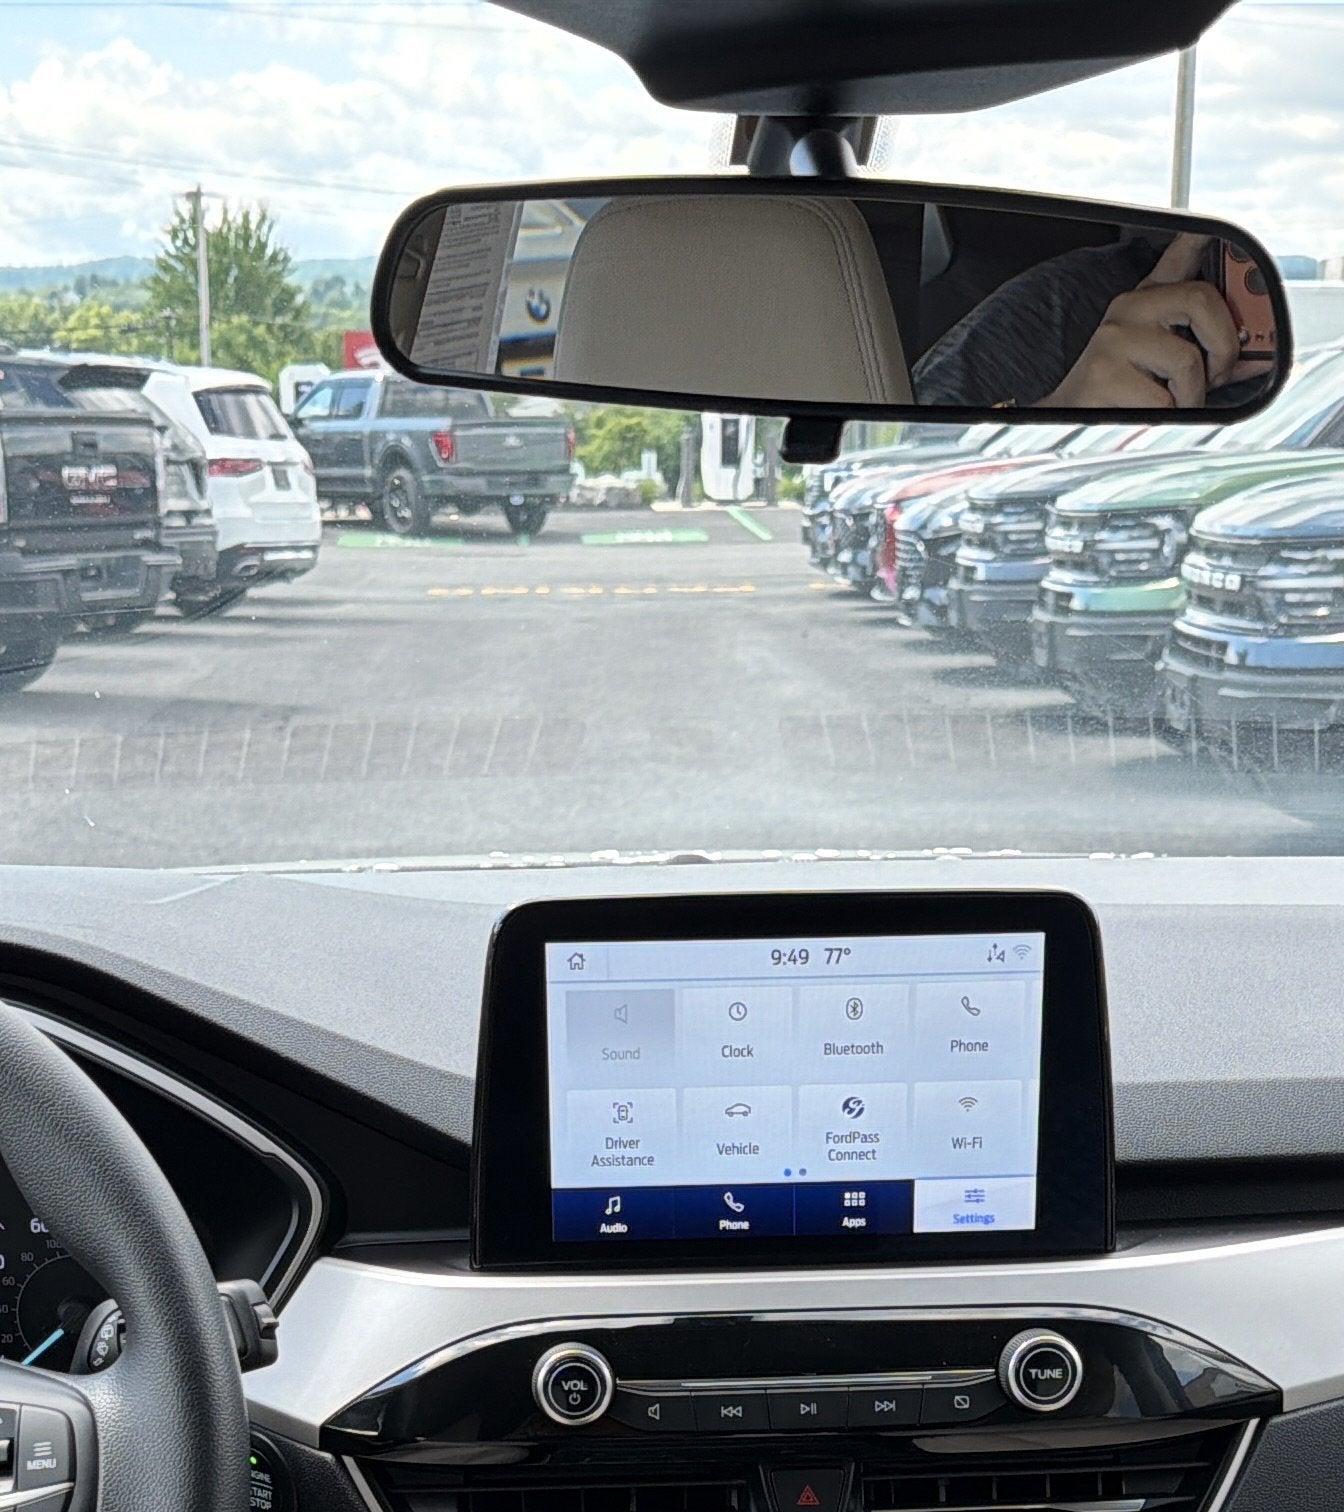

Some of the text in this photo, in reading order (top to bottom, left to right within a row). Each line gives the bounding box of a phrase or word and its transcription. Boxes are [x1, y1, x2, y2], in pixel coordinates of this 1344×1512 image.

[770, 947, 852, 966] 9:49 77°
[720, 1044, 755, 1059] Clock
[823, 1041, 884, 1056] Bluetooth
[950, 1039, 989, 1053] Phone
[601, 1046, 641, 1061] Sound
[605, 1136, 641, 1150] Driver
[825, 1131, 881, 1145] FordPass
[951, 1136, 983, 1150] Wi-Fi
[716, 1142, 760, 1156] Vehicle
[827, 1148, 878, 1162] Connect
[591, 1154, 655, 1168] Assistance
[718, 1219, 750, 1231] Phone
[841, 1216, 867, 1228] Apps
[952, 1212, 996, 1226] Settings
[599, 1222, 629, 1234] Audio
[20, 1251, 35, 1263] 80
[1, 1276, 16, 1287] 60
[0, 1333, 14, 1345] 20
[1029, 1367, 1064, 1380] TUNE
[560, 1379, 589, 1391] VOL
[26, 1458, 57, 1471] MENU
